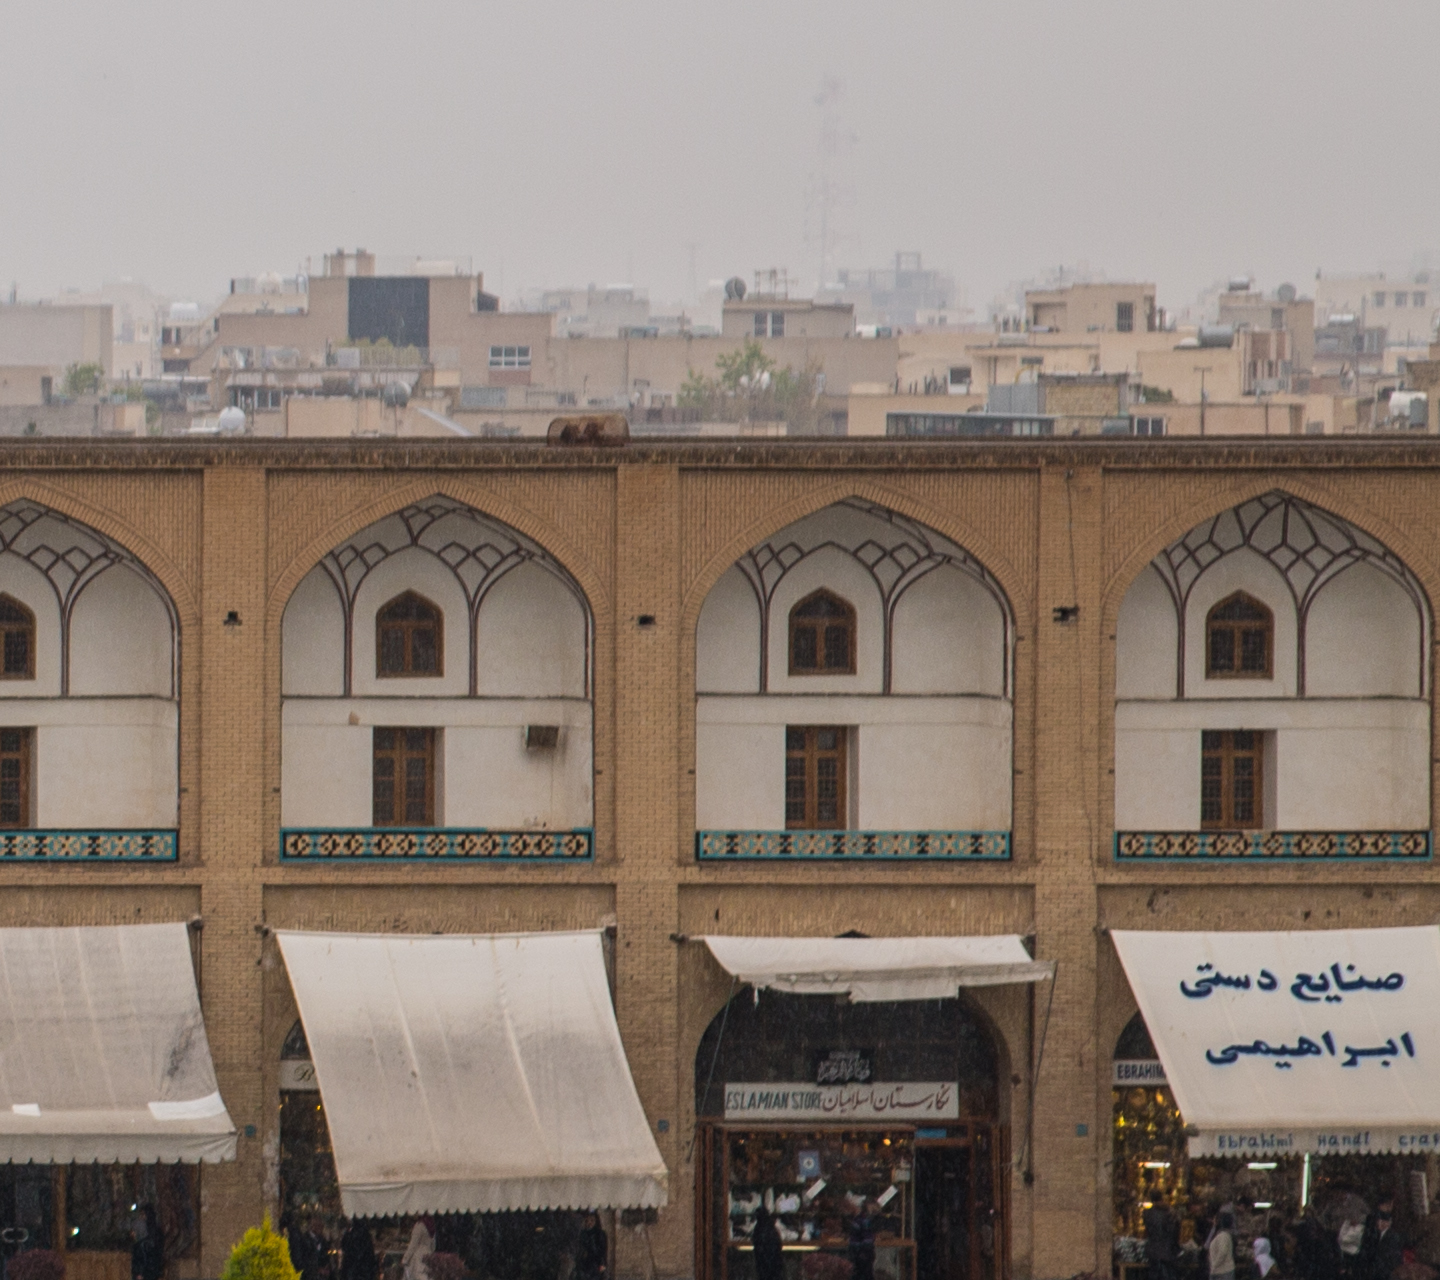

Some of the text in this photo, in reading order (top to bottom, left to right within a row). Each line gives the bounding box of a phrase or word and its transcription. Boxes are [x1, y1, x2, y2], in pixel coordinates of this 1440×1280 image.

[1179, 961, 1405, 1001] صنایع دستی
[1205, 1030, 1416, 1068] ابراهیمی
[725, 1090, 822, 1111] ESLAMIAN STORE
[1217, 1132, 1294, 1150] Ebrahimi
[1317, 1131, 1370, 1148] Handi
